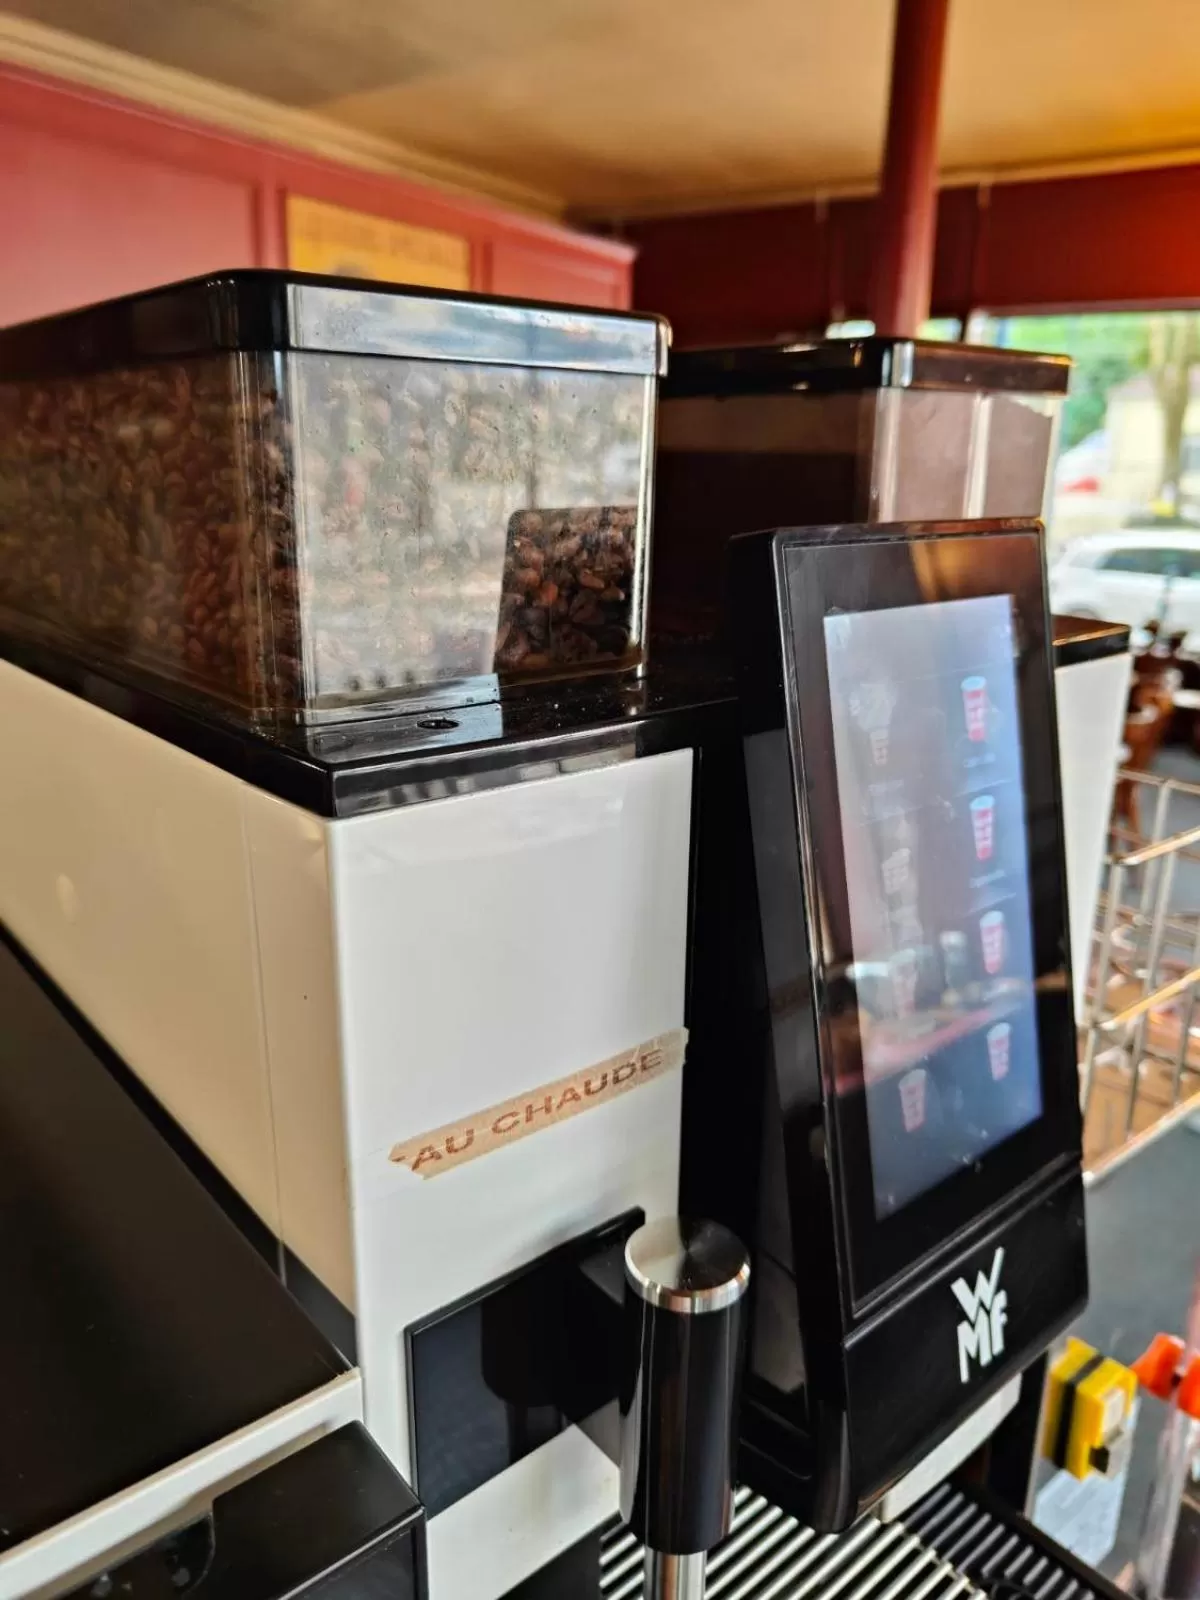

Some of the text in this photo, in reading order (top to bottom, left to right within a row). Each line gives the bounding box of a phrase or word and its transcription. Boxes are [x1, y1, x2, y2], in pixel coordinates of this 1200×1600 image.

[391, 1049, 663, 1172] AU CHAUDE
[951, 1247, 1008, 1384] WMF
